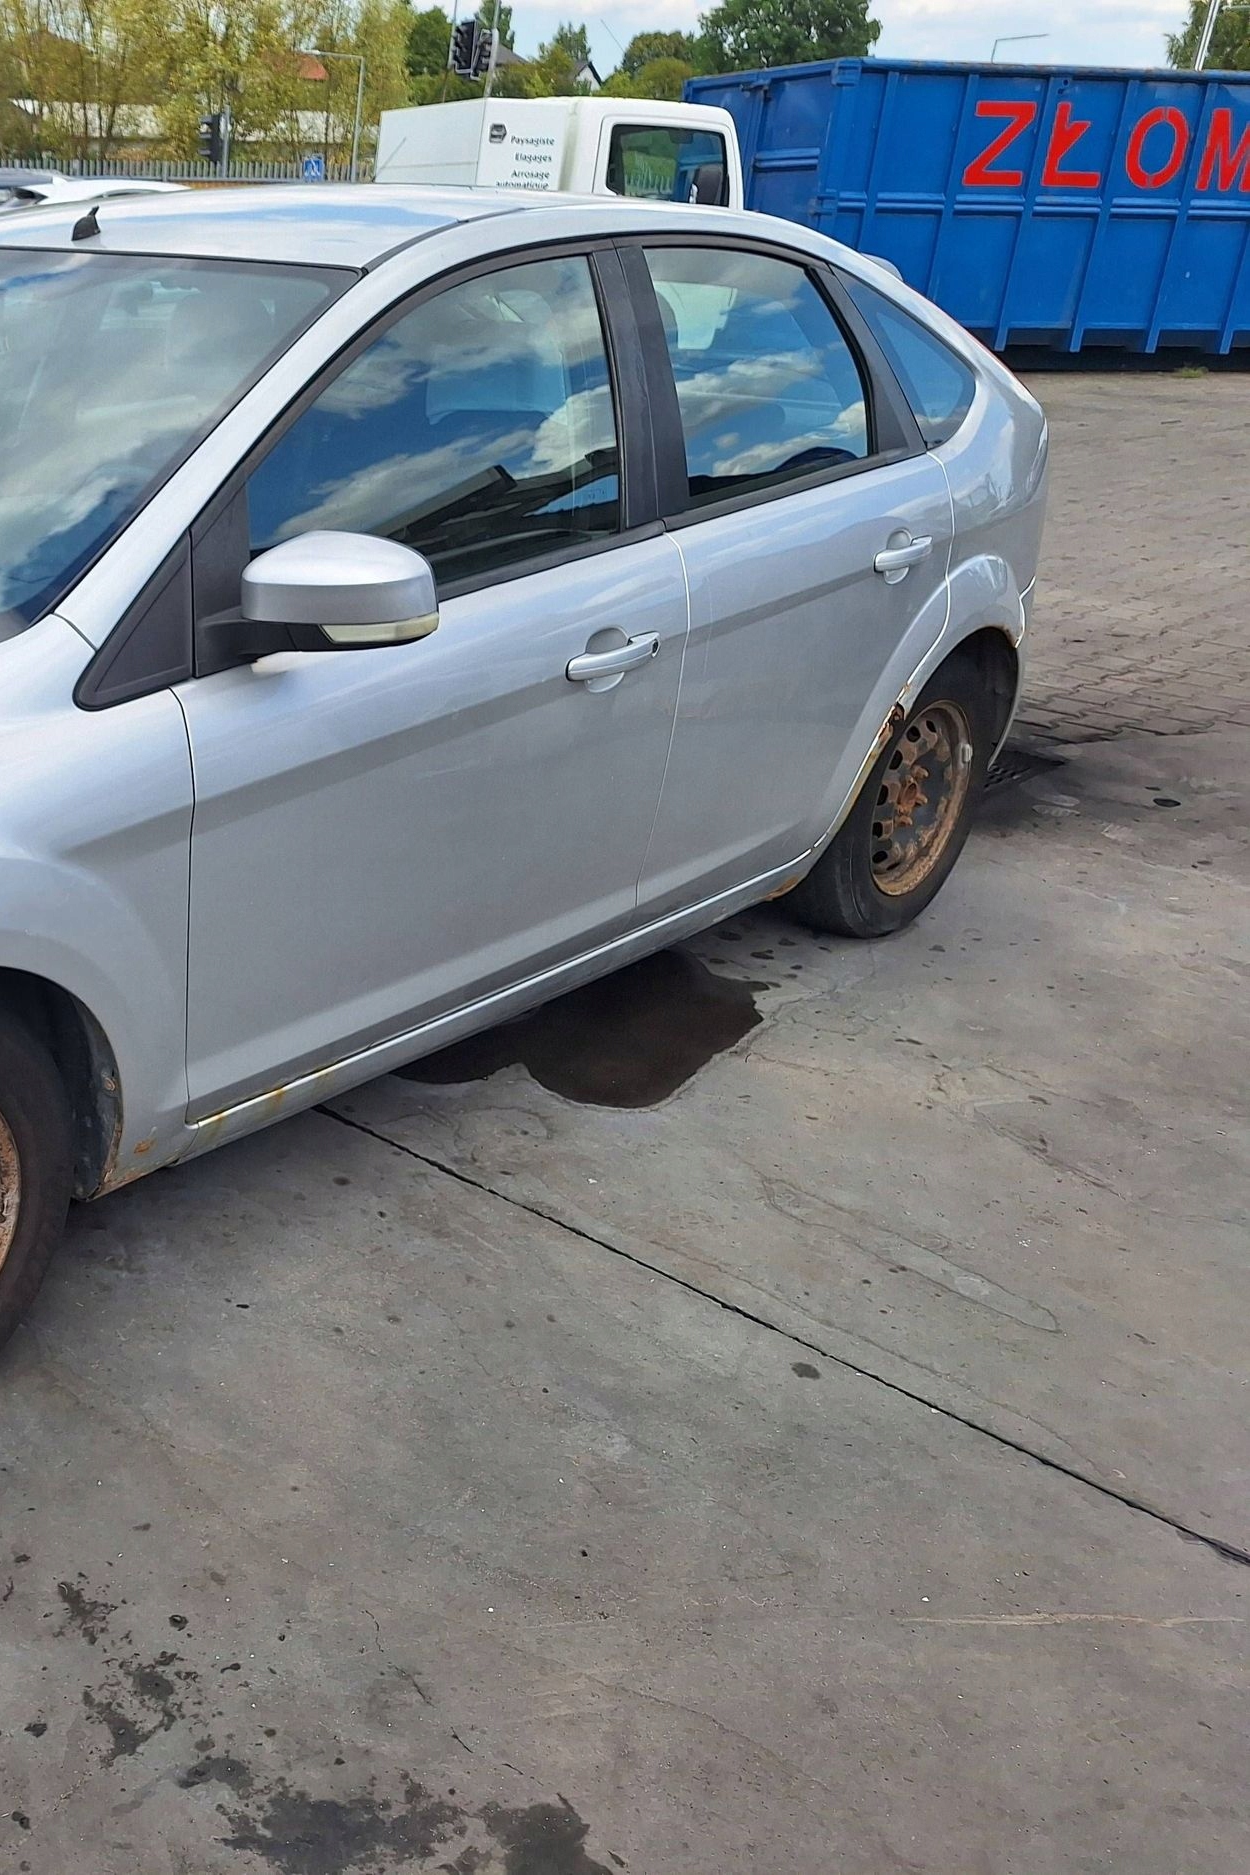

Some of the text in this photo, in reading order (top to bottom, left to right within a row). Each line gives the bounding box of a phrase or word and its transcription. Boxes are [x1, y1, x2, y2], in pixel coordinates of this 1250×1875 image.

[511, 135, 555, 147] Paysagiste
[962, 100, 1250, 192] ZŁOM
[511, 169, 551, 181] Arrosage
